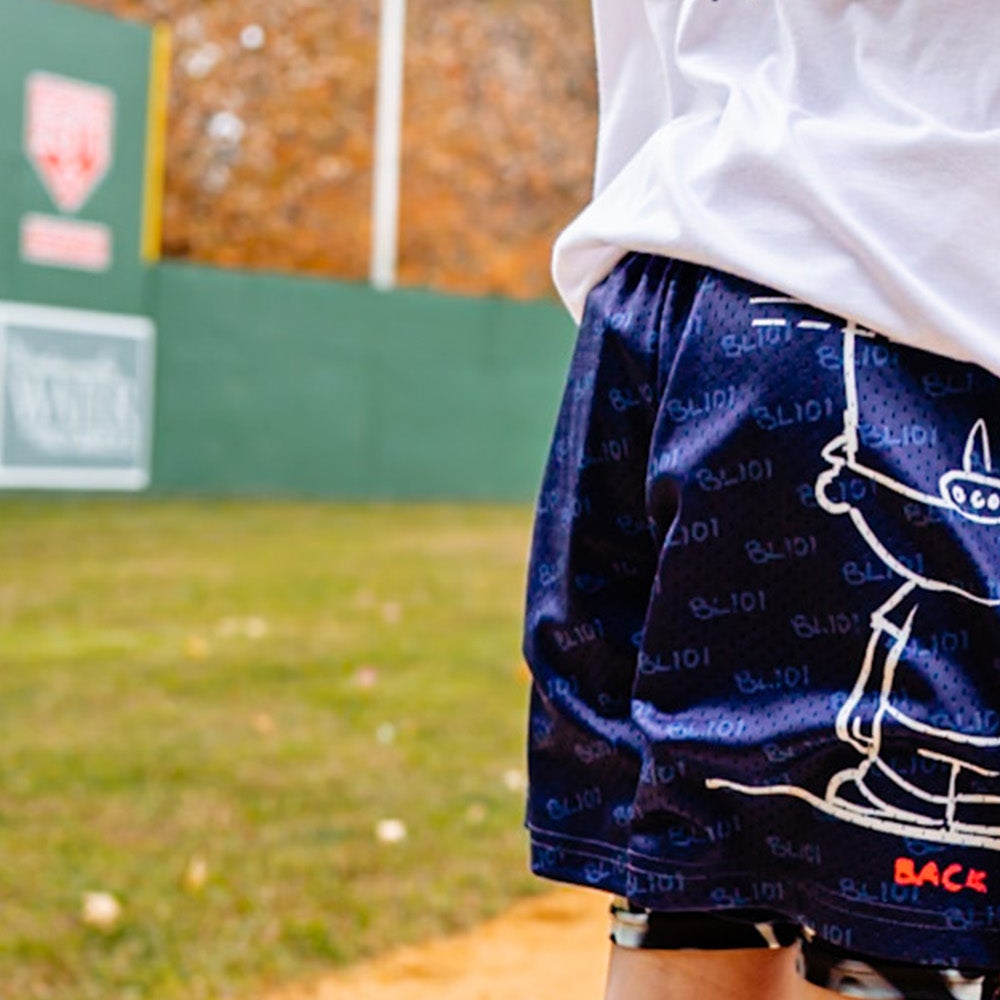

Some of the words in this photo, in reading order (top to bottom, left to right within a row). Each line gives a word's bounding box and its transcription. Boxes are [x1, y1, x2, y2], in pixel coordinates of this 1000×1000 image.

[667, 385, 736, 423] BL101
[754, 398, 834, 430] BL101
[859, 423, 937, 446] BL101
[697, 457, 773, 491] BL101
[744, 535, 818, 566] BL101
[689, 590, 767, 620] BL101
[734, 664, 810, 695] BL101
[838, 876, 921, 903] BL101
[892, 855, 989, 895] BACK
[709, 879, 785, 908] BL101
